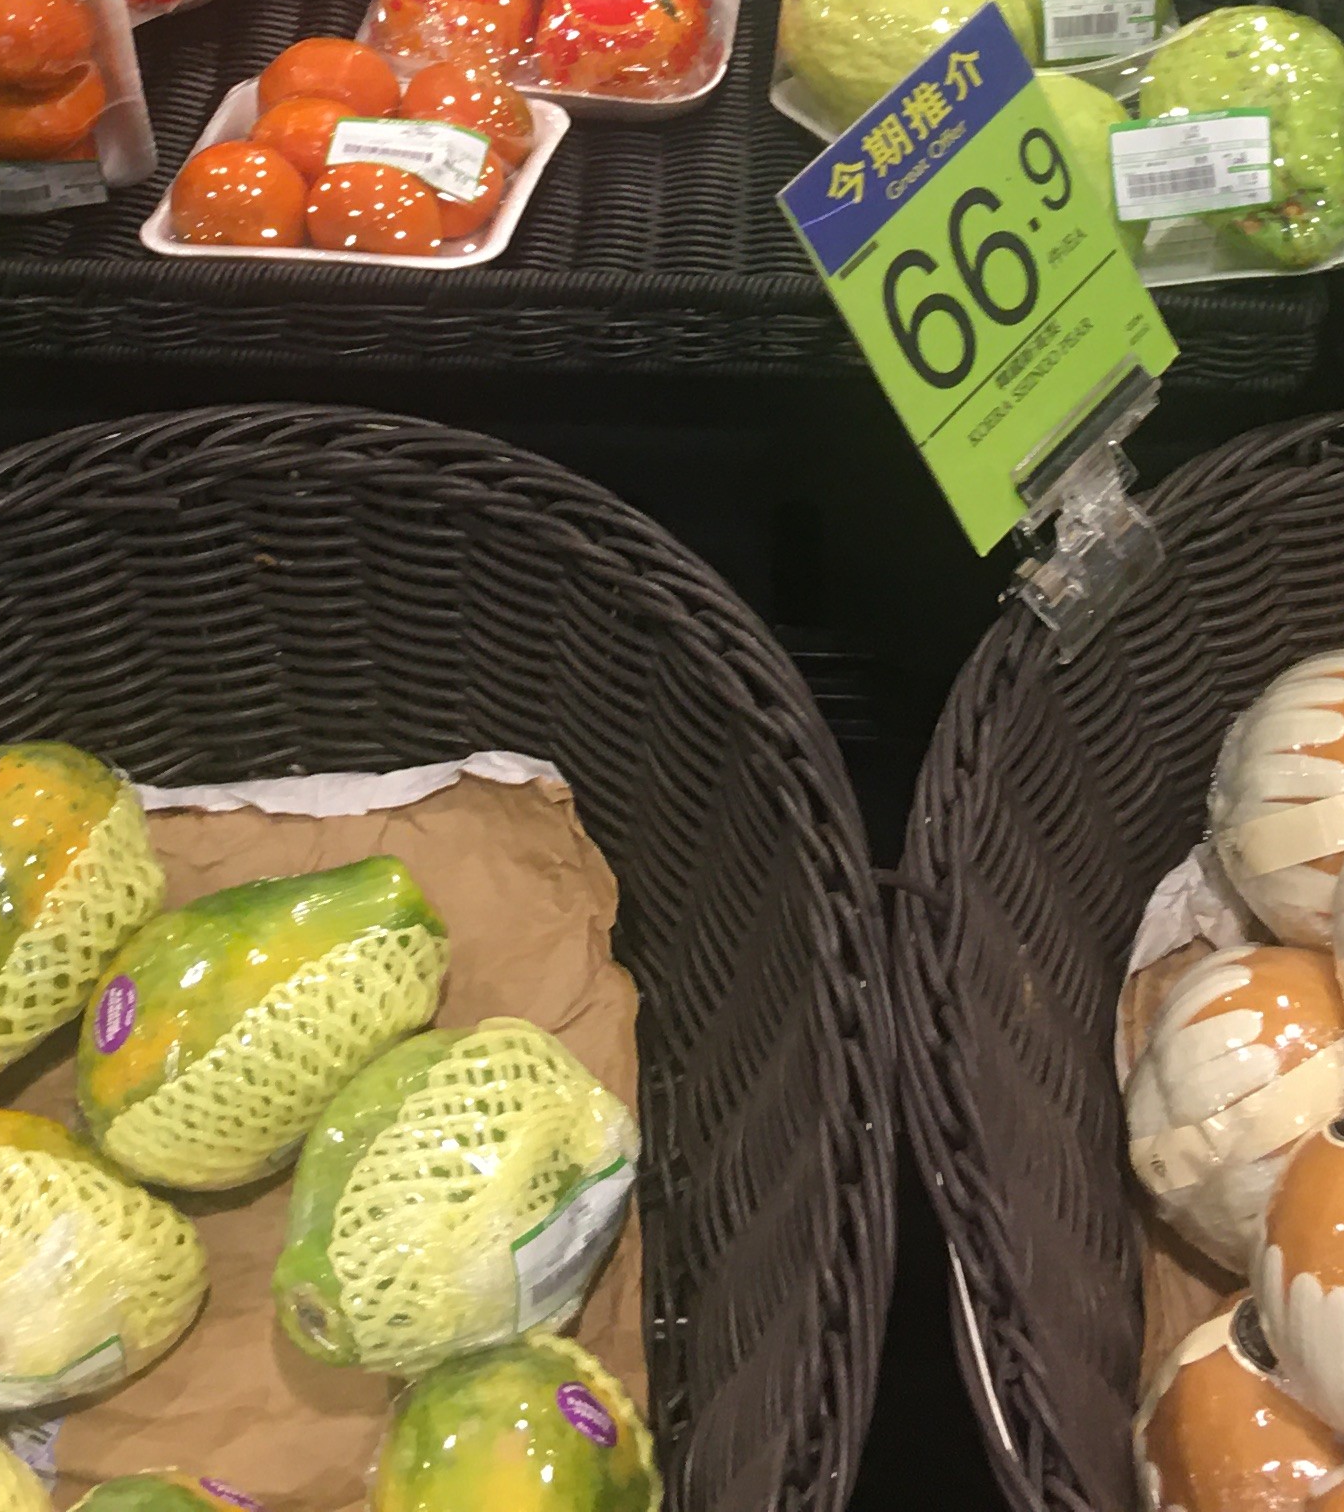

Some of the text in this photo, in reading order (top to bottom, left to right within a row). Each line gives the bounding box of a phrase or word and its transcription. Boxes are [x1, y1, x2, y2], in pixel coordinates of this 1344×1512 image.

[826, 50, 982, 205] 今期推介
[885, 120, 968, 200] Great Offer
[882, 127, 1072, 390] 66.9
